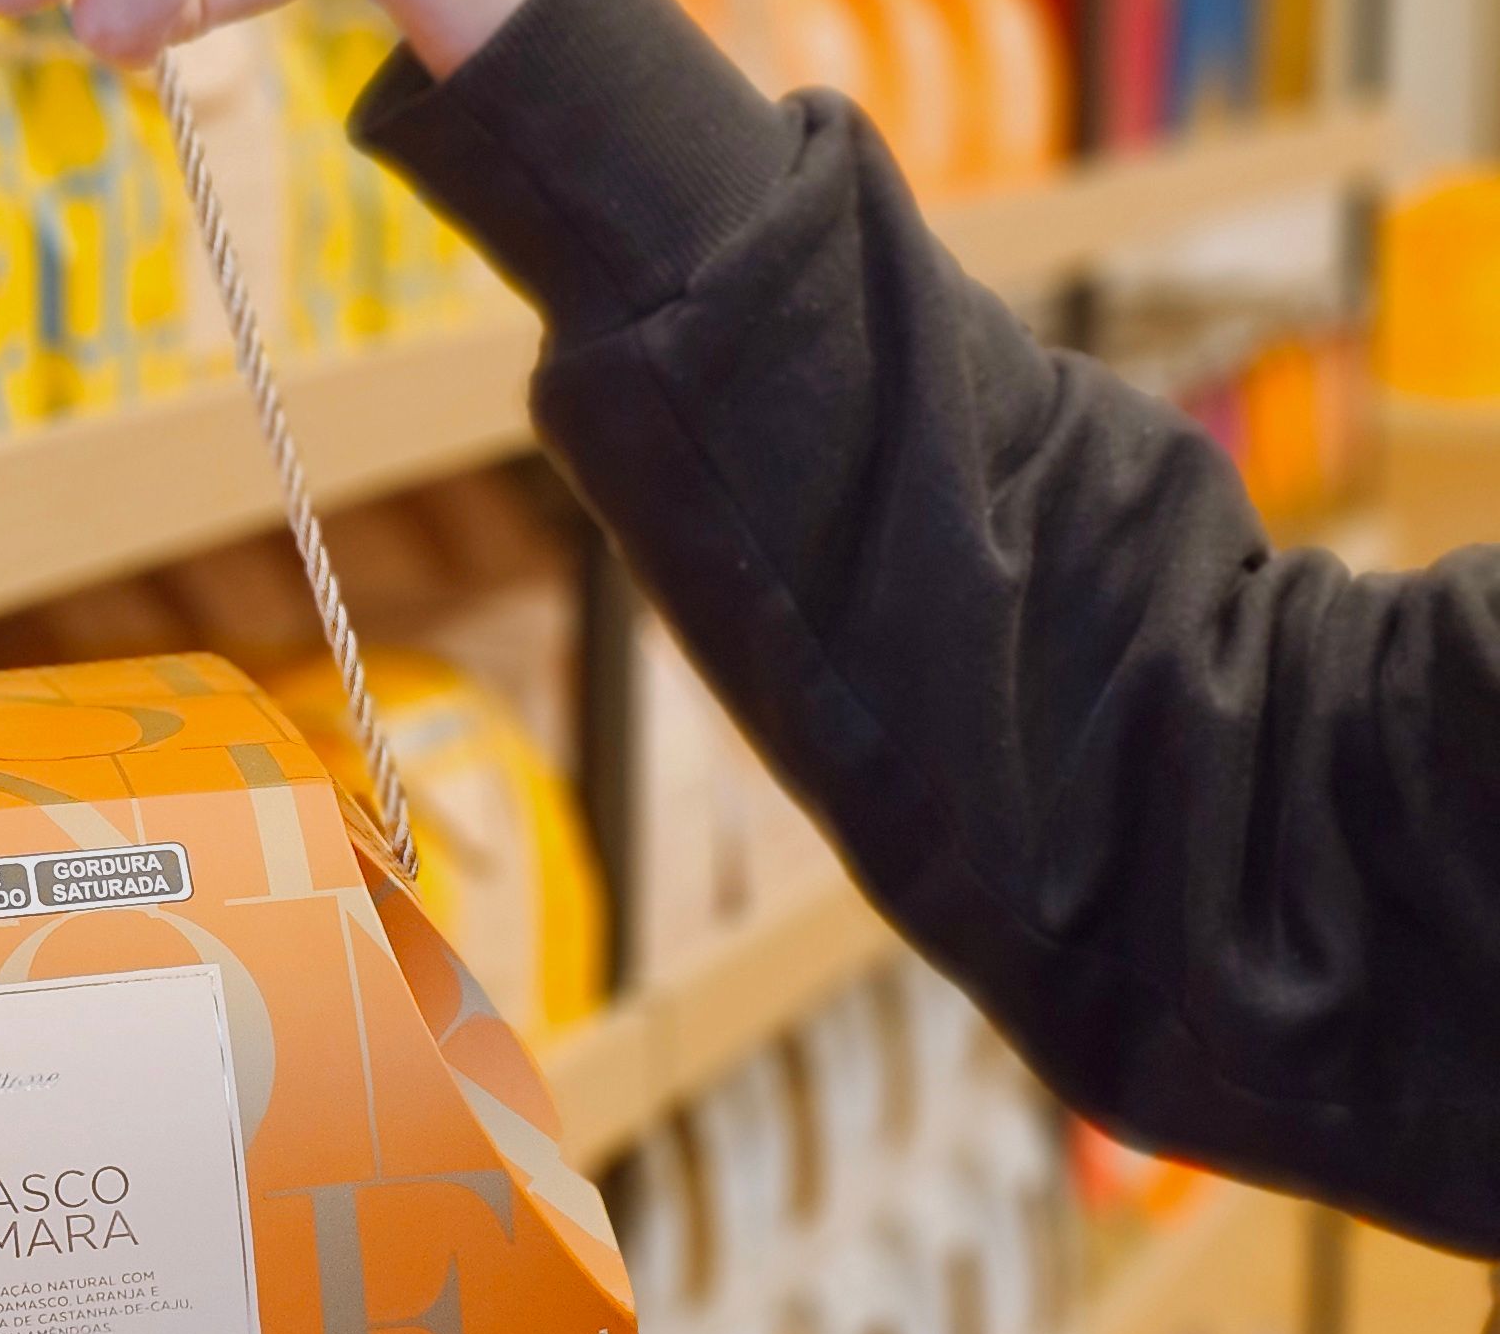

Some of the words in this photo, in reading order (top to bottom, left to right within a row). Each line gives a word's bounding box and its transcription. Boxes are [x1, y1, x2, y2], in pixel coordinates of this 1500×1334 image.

[53, 853, 163, 881] GORDURA
[52, 874, 171, 904] SATURADA
[47, 1276, 116, 1292] NATURAL
[122, 1271, 156, 1284] COM
[77, 1288, 145, 1305] LARANJA
[152, 1286, 160, 1297] E
[14, 1316, 32, 1328] DE
